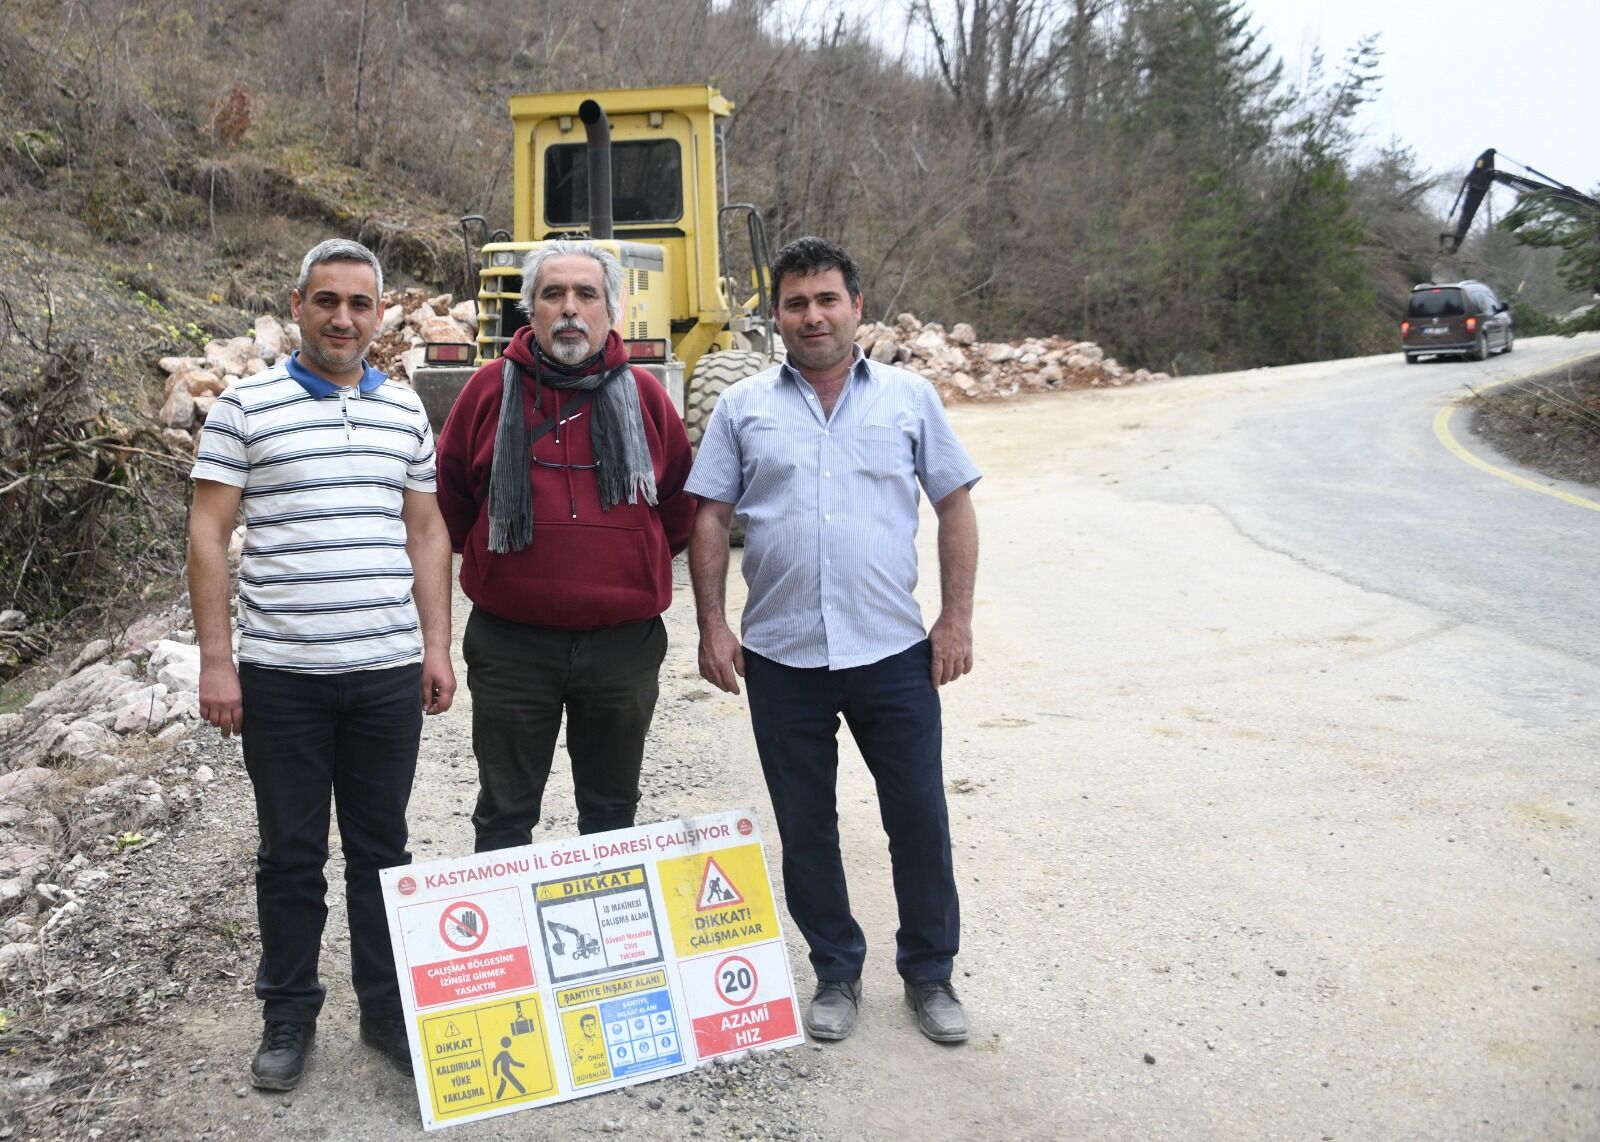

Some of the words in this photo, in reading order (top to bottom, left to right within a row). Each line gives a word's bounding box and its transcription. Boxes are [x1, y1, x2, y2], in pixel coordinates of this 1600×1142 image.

[425, 859, 529, 888] KASTAMONU
[533, 854, 548, 870] İL
[550, 849, 591, 867] ÖZEL
[593, 834, 652, 860] İDARESİ
[655, 824, 731, 852] ÇALIŞIYOR
[611, 898, 642, 912] MAKİNESİ
[690, 930, 739, 950] ÇALIŞMA
[742, 923, 763, 937] VAR
[428, 962, 466, 980] ÇALIŞMA
[467, 953, 515, 970] BÖLGESİNE
[472, 967, 506, 982] GİRMEK
[455, 981, 496, 996] YASAKTIR
[564, 987, 601, 1003] ŞANTİYE
[602, 980, 633, 994] İNŞAAT
[636, 975, 660, 985] ALANI
[722, 967, 752, 994] 20
[721, 1003, 770, 1032] AZAMİ
[735, 1028, 762, 1046] HIZ
[436, 1058, 481, 1077] KALDIRILAN
[451, 1075, 471, 1088] YÜKE
